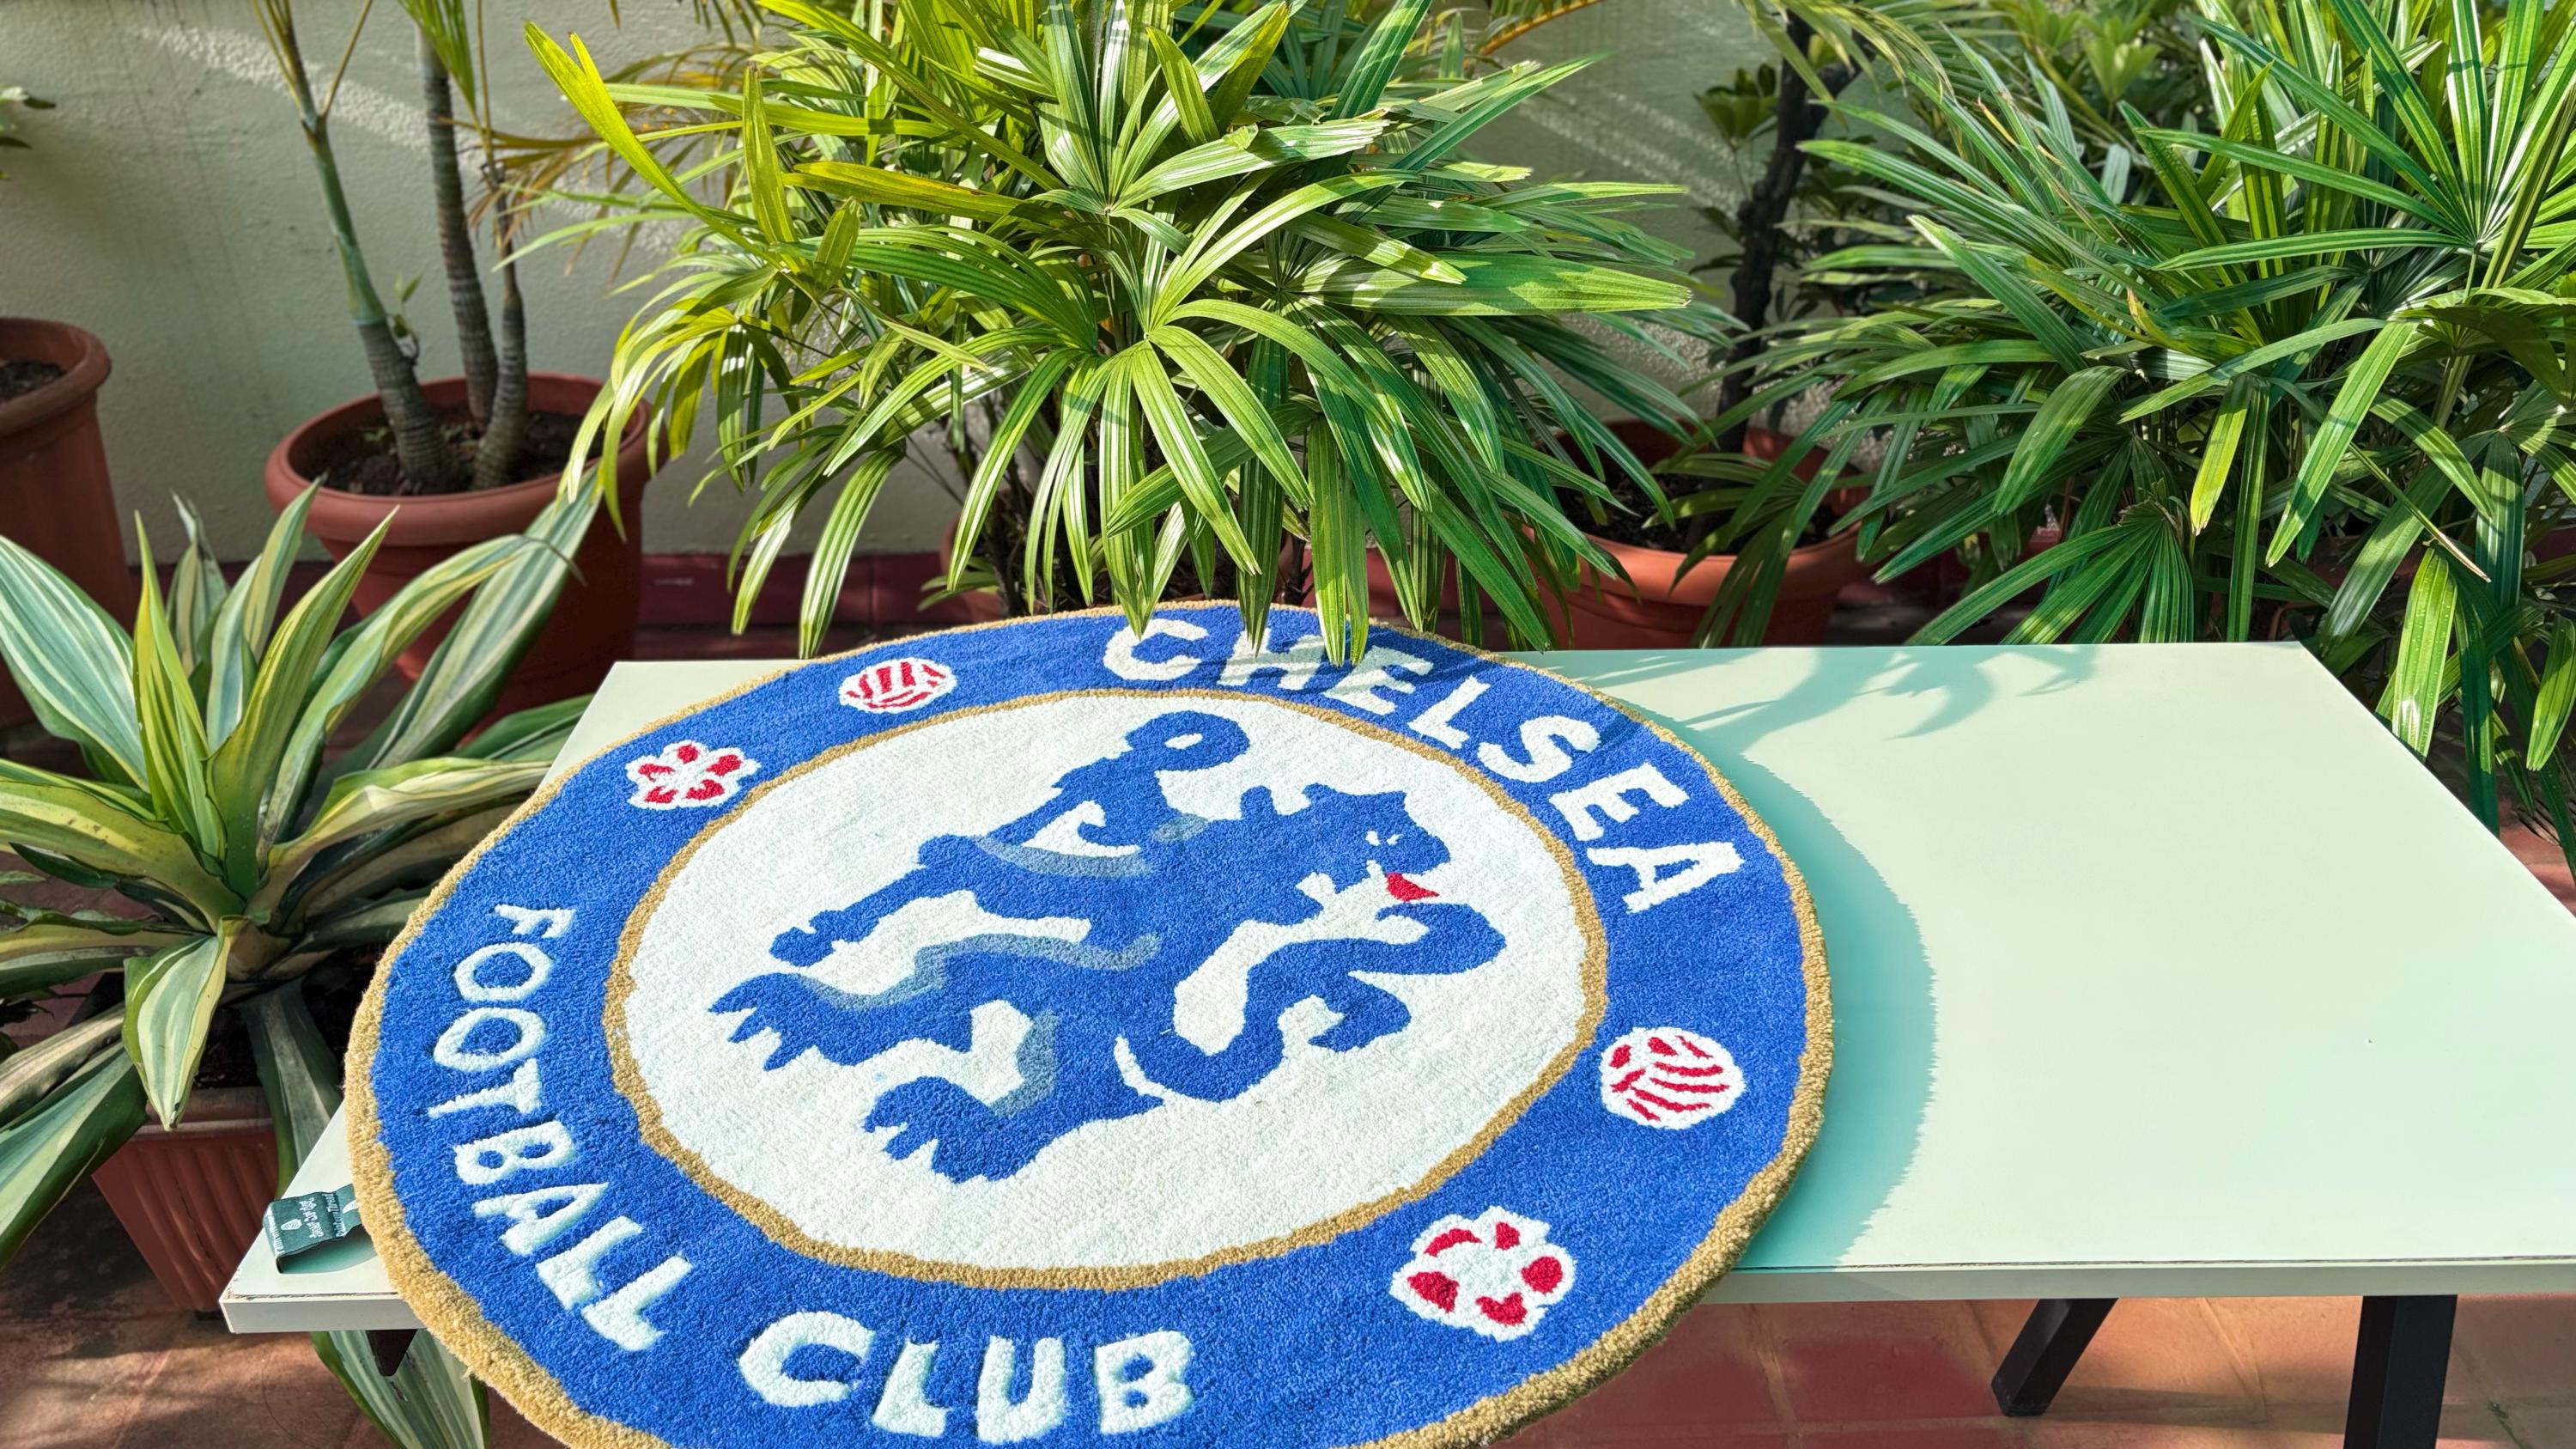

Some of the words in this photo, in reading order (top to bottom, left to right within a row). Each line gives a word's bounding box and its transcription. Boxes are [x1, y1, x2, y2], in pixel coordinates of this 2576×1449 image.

[1103, 618, 1745, 915] CHELSEA
[428, 904, 694, 1351] FOOTBALL
[738, 1311, 1196, 1442] CLUB
